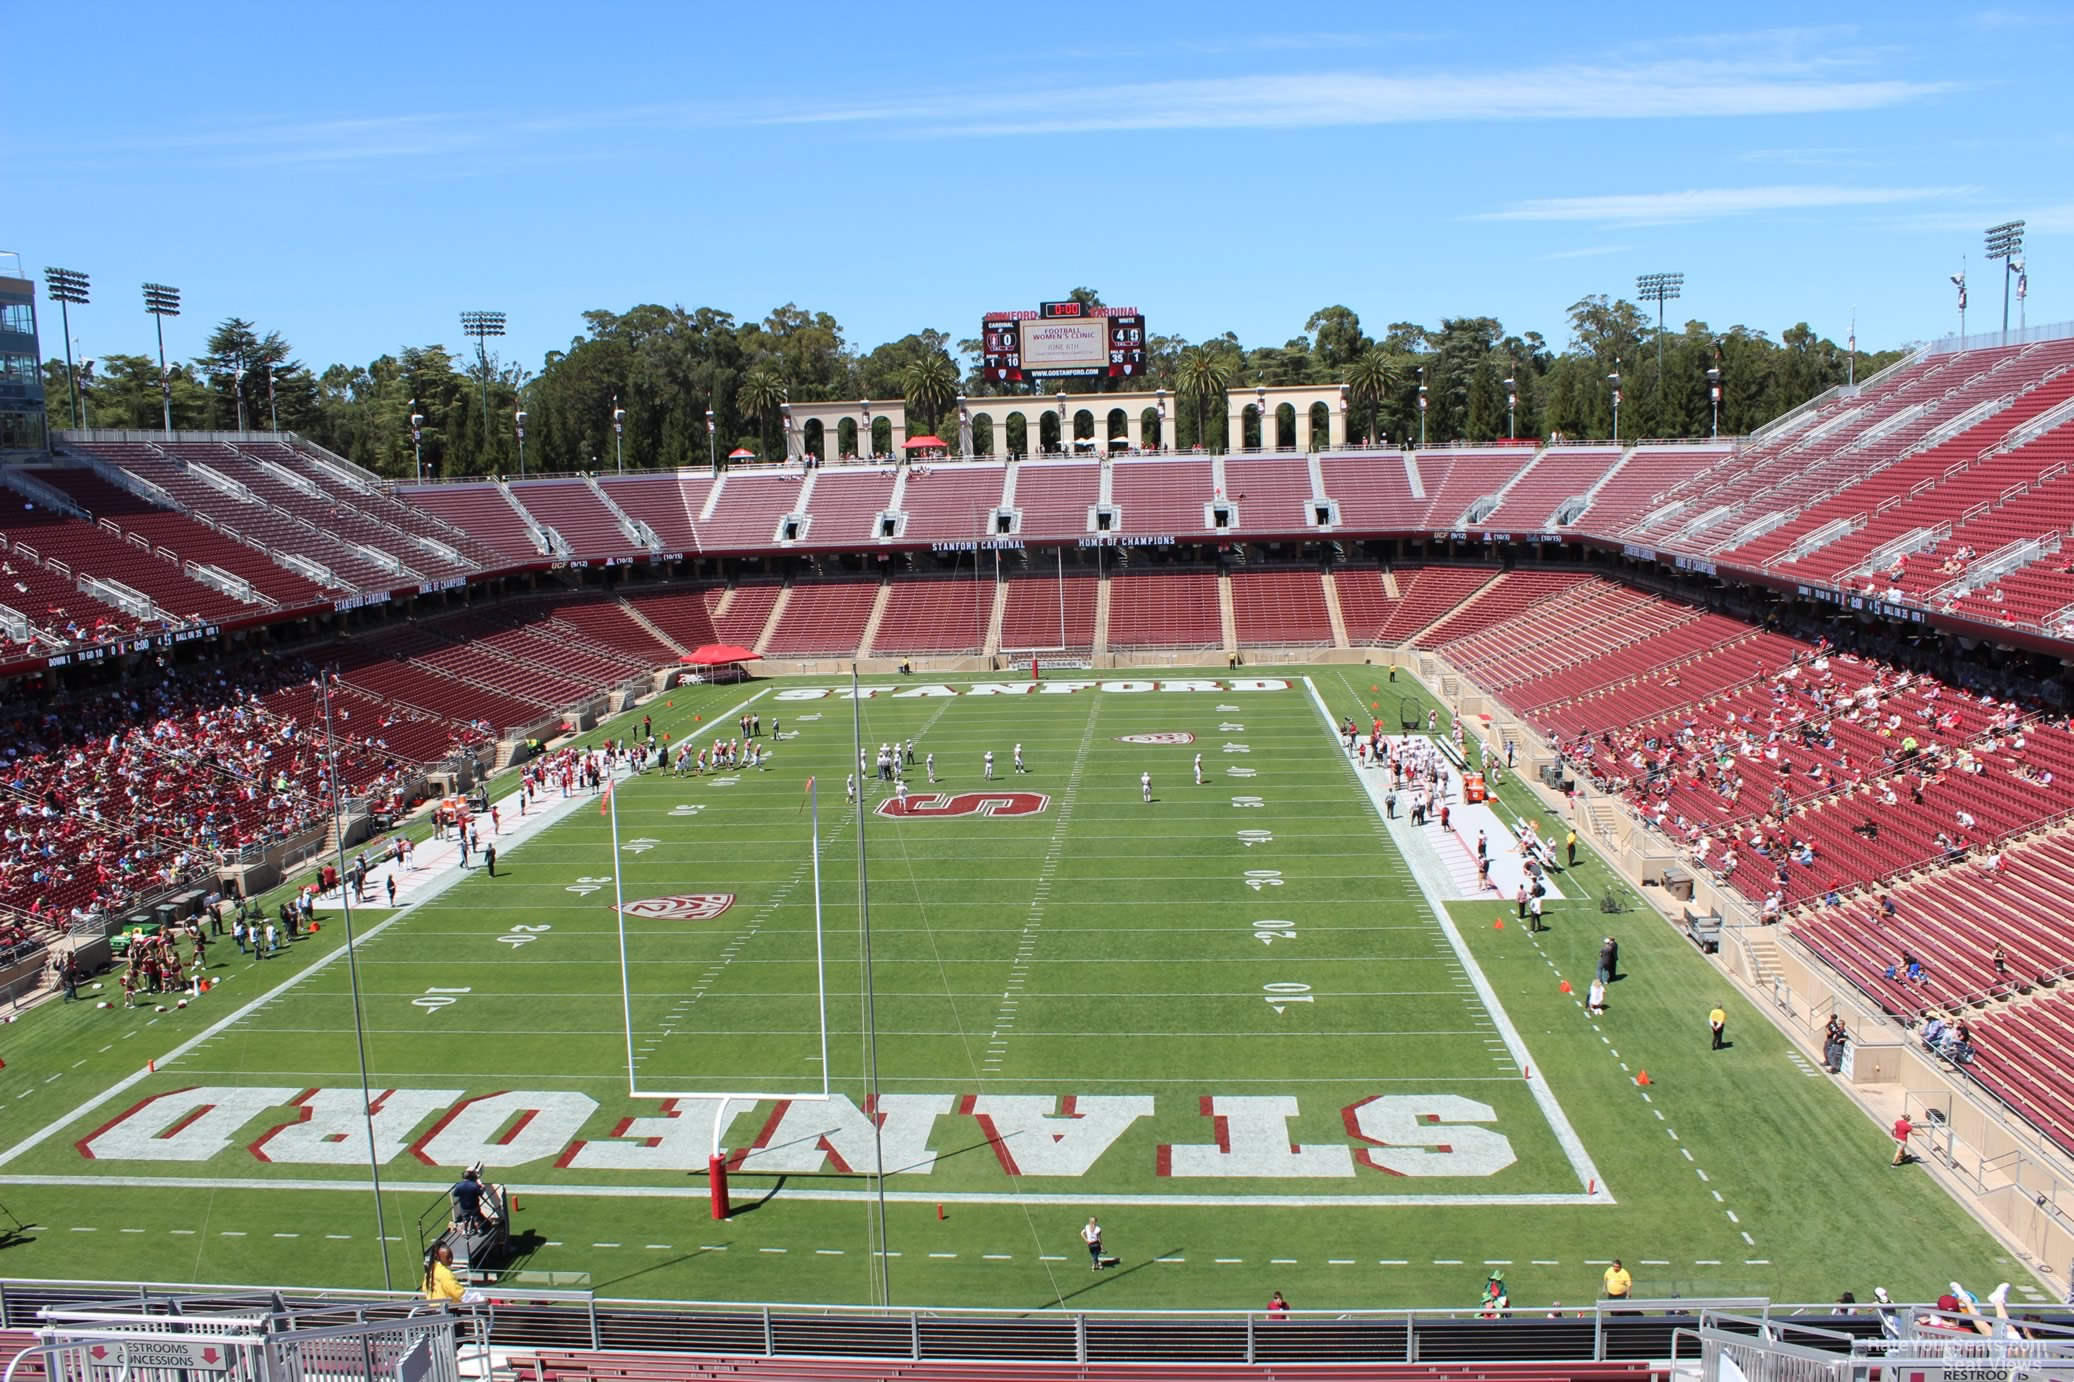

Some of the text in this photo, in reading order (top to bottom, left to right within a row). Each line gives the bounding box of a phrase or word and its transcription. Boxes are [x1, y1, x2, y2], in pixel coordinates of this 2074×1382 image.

[1054, 304, 1078, 314] 0:00
[1004, 334, 1012, 346] 0
[1116, 330, 1124, 342] 4
[1008, 358, 1018, 366] 10
[1112, 354, 1124, 363] 35
[932, 540, 1025, 551] STANFORD CARDINAL
[1079, 536, 1175, 547] HOME OF CHAMPIONS
[334, 592, 391, 612] STANFORD CARDINAL
[1902, 608, 1908, 619] 35
[176, 634, 187, 642] BALL
[196, 630, 202, 638] 35
[111, 646, 116, 655] 0
[134, 639, 149, 651] 0:00
[48, 655, 66, 667] DOWN
[78, 649, 103, 661] TO GO 10
[774, 679, 1294, 701] STANFORD
[872, 792, 1051, 818] S
[565, 876, 613, 892] 30
[1244, 870, 1284, 886] 30
[496, 924, 552, 944] 20
[1252, 920, 1298, 939] 20
[411, 986, 472, 1008] 10
[1263, 983, 1314, 1002] 10
[75, 1086, 1518, 1177] STANFORD
